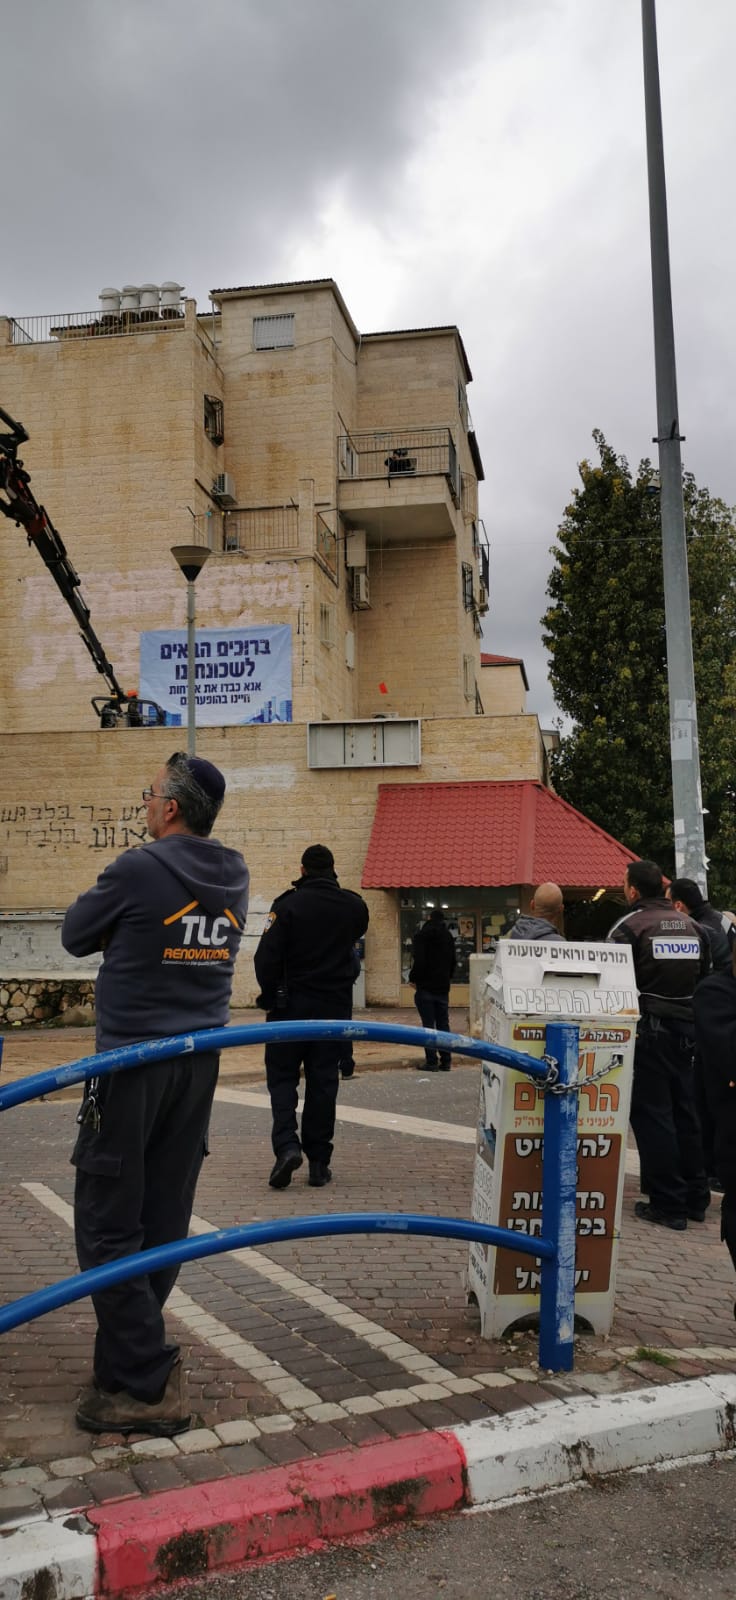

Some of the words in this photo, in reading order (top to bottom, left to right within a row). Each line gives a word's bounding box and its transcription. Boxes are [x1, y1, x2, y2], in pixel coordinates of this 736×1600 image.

[216, 638, 271, 657] ברוכים
[203, 683, 218, 694] את
[220, 682, 241, 692] כבדו
[243, 681, 262, 691] אנא
[181, 915, 231, 946] TLC
[508, 944, 547, 958] ישועות
[550, 947, 585, 961] ורואים
[654, 943, 699, 954] משטרה
[588, 950, 628, 964] תורמים
[509, 987, 591, 1013] הרבנים
[594, 990, 634, 1015] ועד
[588, 1030, 625, 1042] הצדקה
